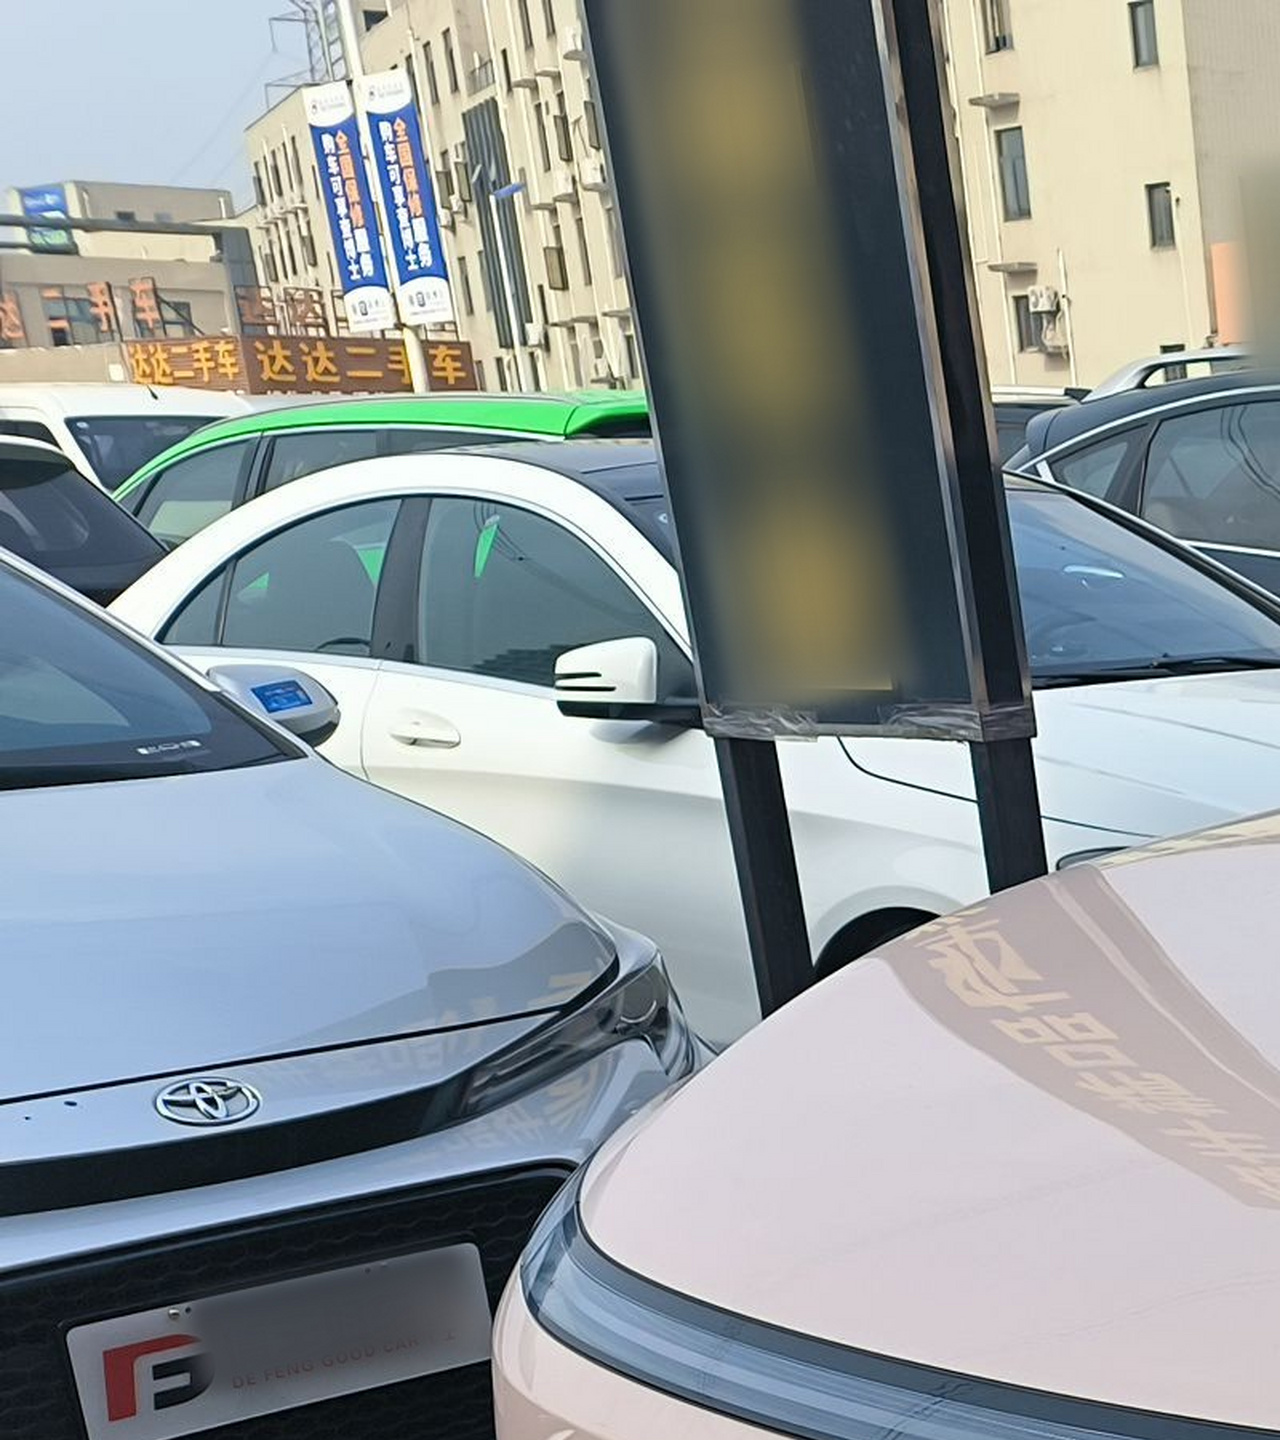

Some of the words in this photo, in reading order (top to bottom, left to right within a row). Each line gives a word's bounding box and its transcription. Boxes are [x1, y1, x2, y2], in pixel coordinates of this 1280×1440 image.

[129, 341, 239, 385] 达达二手车
[254, 340, 466, 385] 达达二手车
[321, 1346, 376, 1367] GOOD
